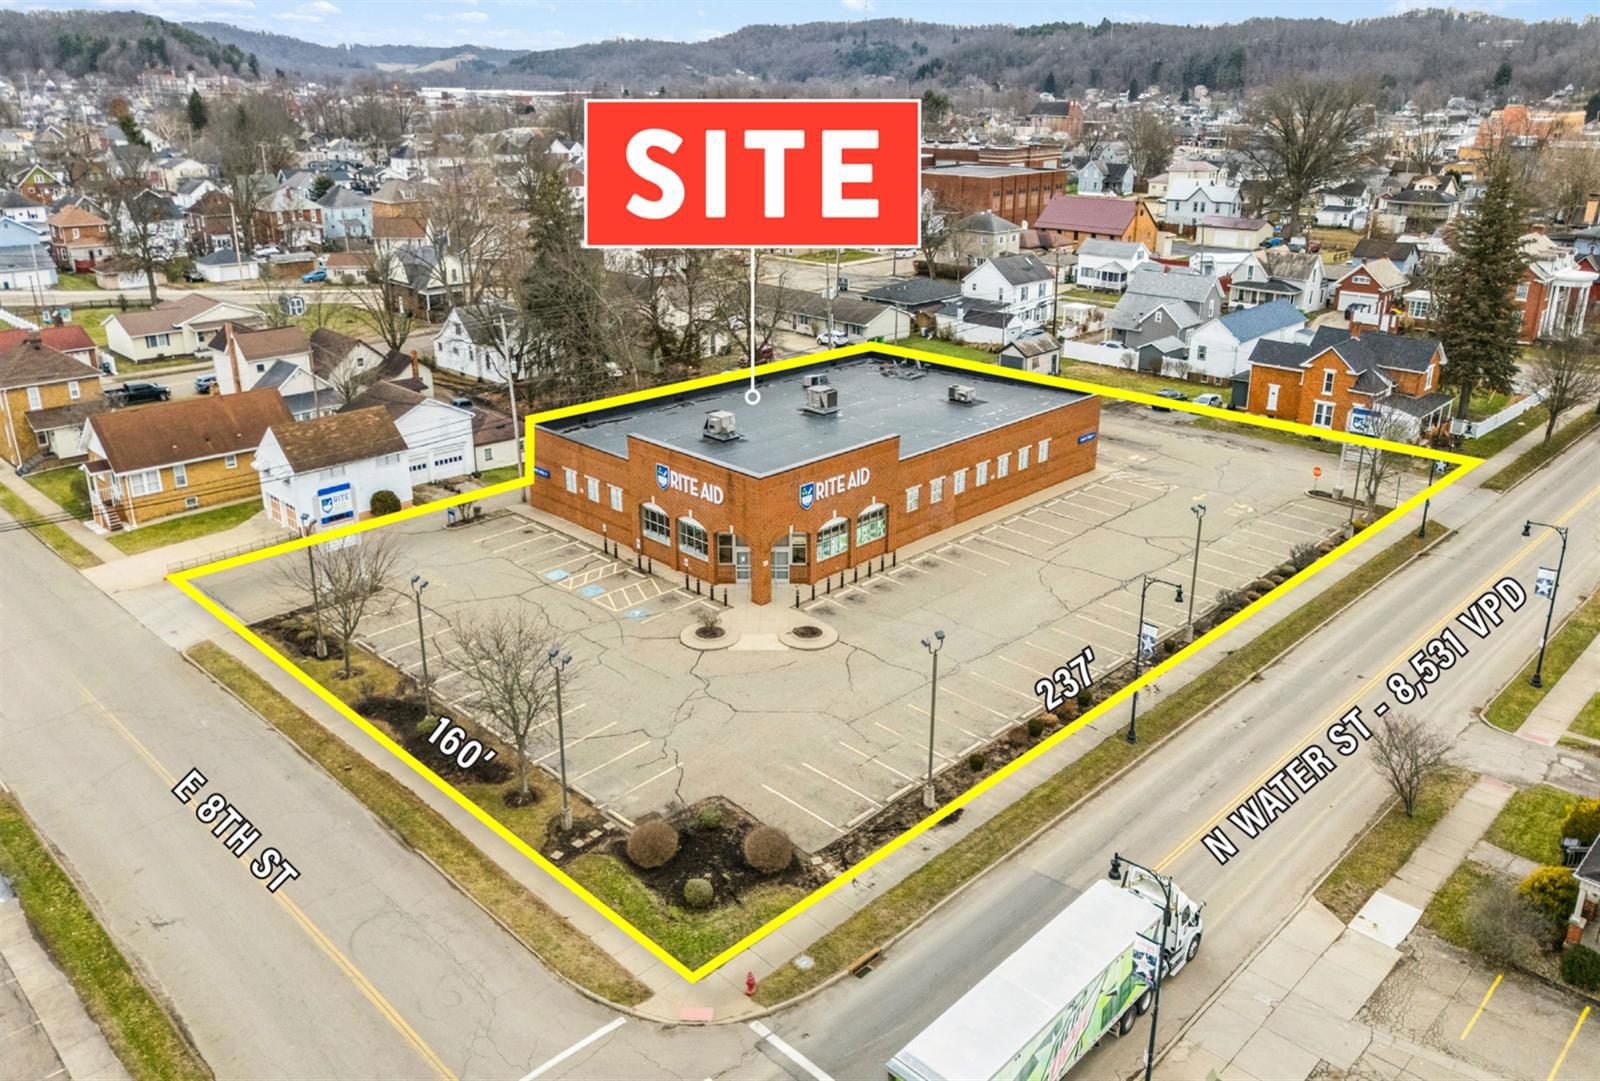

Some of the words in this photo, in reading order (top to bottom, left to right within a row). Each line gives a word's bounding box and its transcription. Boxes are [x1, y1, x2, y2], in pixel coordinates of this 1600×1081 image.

[670, 471, 698, 496] RITE
[700, 481, 724, 505] AID
[815, 474, 845, 500] RITE
[847, 467, 870, 489] AID
